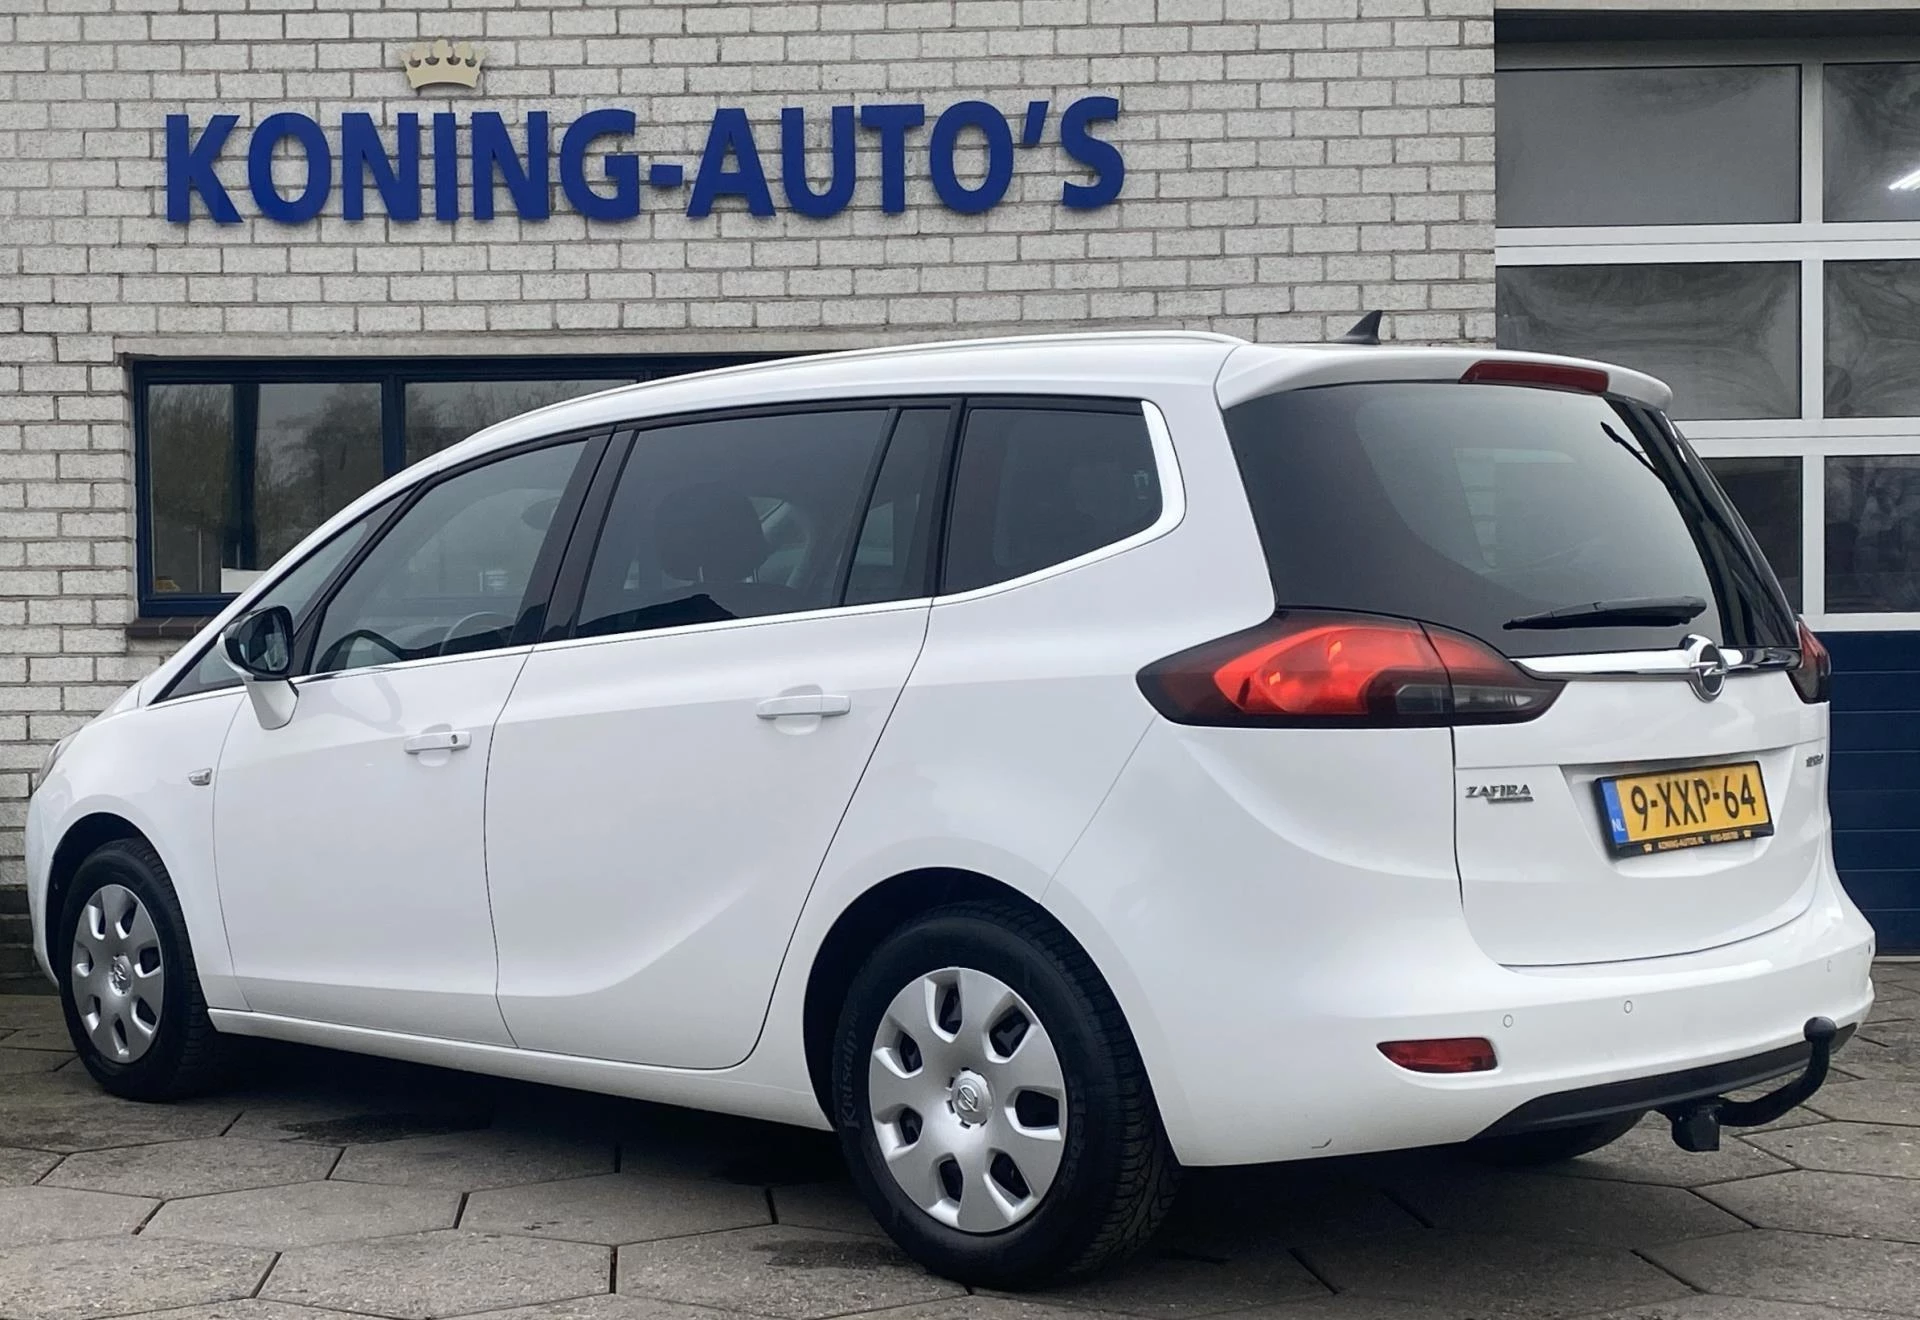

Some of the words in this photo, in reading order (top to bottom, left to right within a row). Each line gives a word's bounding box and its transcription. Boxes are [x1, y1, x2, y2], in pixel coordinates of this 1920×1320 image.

[166, 96, 1125, 223] KONING-AUTO'S
[1465, 784, 1531, 798] ZAFIRA
[1631, 774, 1756, 831] 9-XXP-64
[1611, 817, 1626, 833] NL
